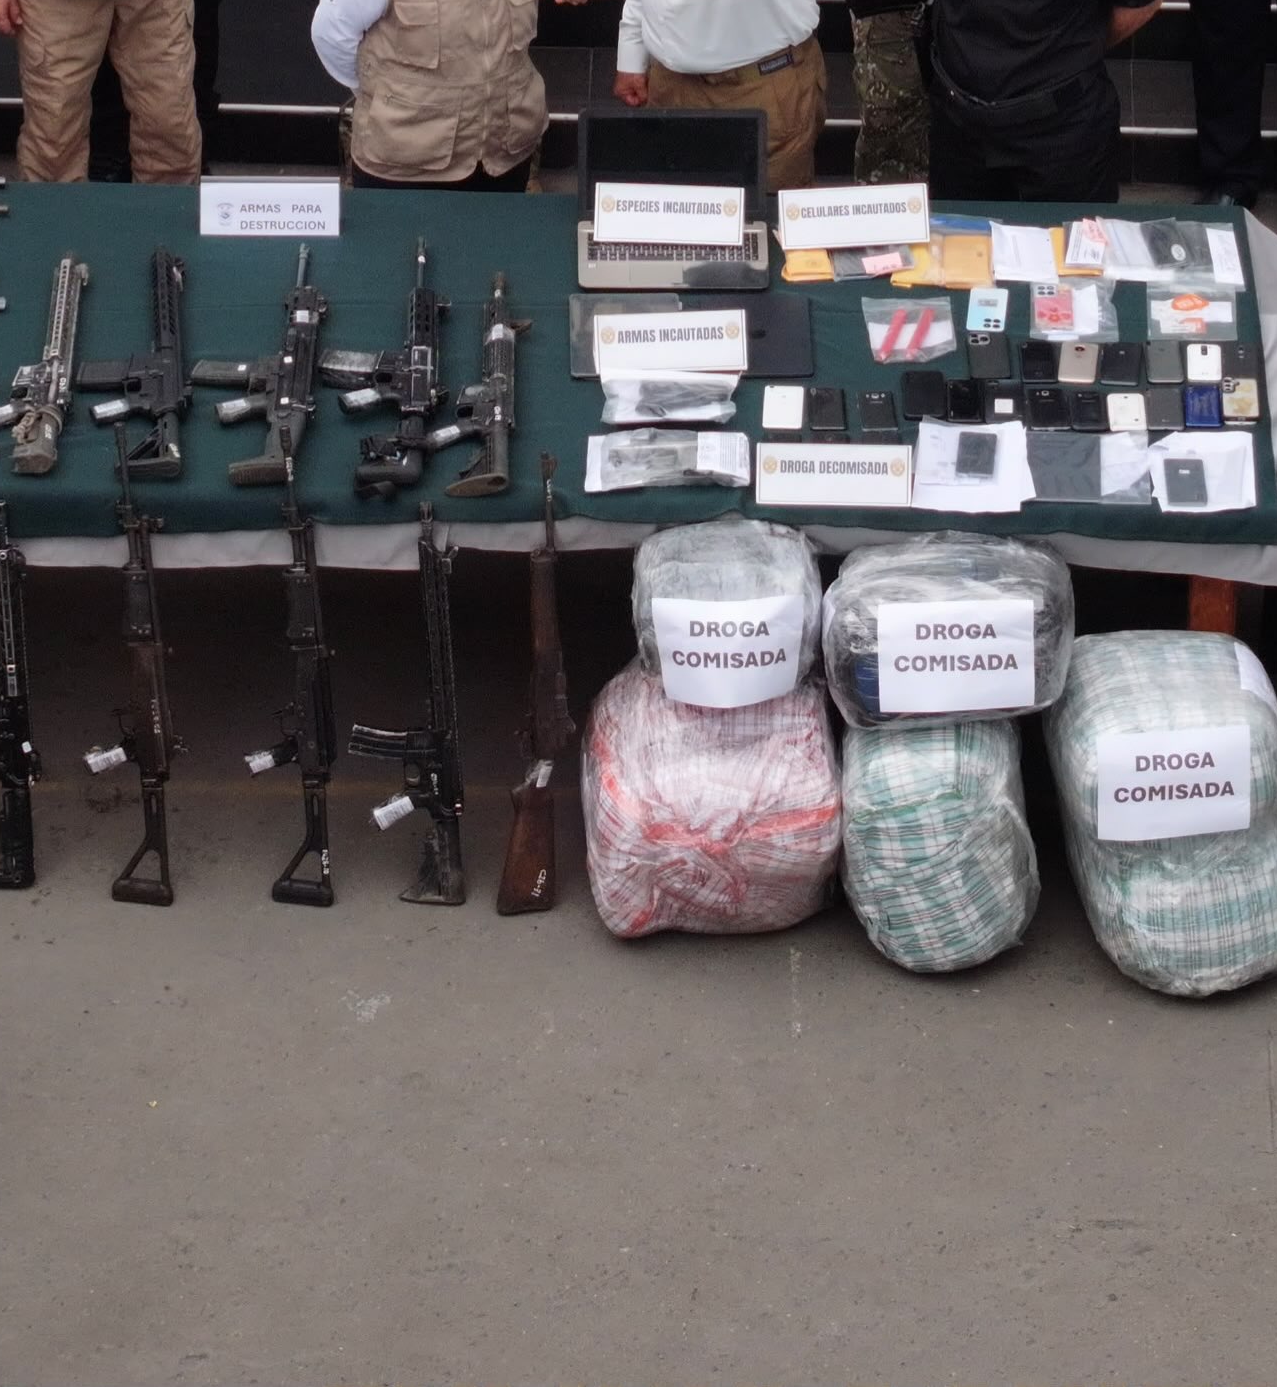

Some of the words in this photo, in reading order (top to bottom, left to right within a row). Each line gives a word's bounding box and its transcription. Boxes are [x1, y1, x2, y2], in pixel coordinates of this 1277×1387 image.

[239, 202, 282, 214] ARMAS
[290, 202, 323, 214] PARA
[615, 199, 660, 214] ESPECIES
[662, 201, 723, 216] INCAUTADAS
[801, 204, 850, 219] CELULARES
[852, 201, 908, 217] INCAUTADOS
[239, 219, 326, 231] DESTRUCCION
[617, 330, 656, 345] ARMAS
[658, 326, 724, 343] INCAUTADAS
[780, 459, 816, 475] DROGA
[818, 460, 890, 477] DECOMISADA
[688, 619, 771, 638] DROGA
[914, 622, 998, 641] DROGA
[671, 648, 788, 670] COMISADA
[893, 653, 1020, 673] COMISADA
[1133, 751, 1217, 773] DROGA
[1112, 780, 1237, 804] COMISADA
